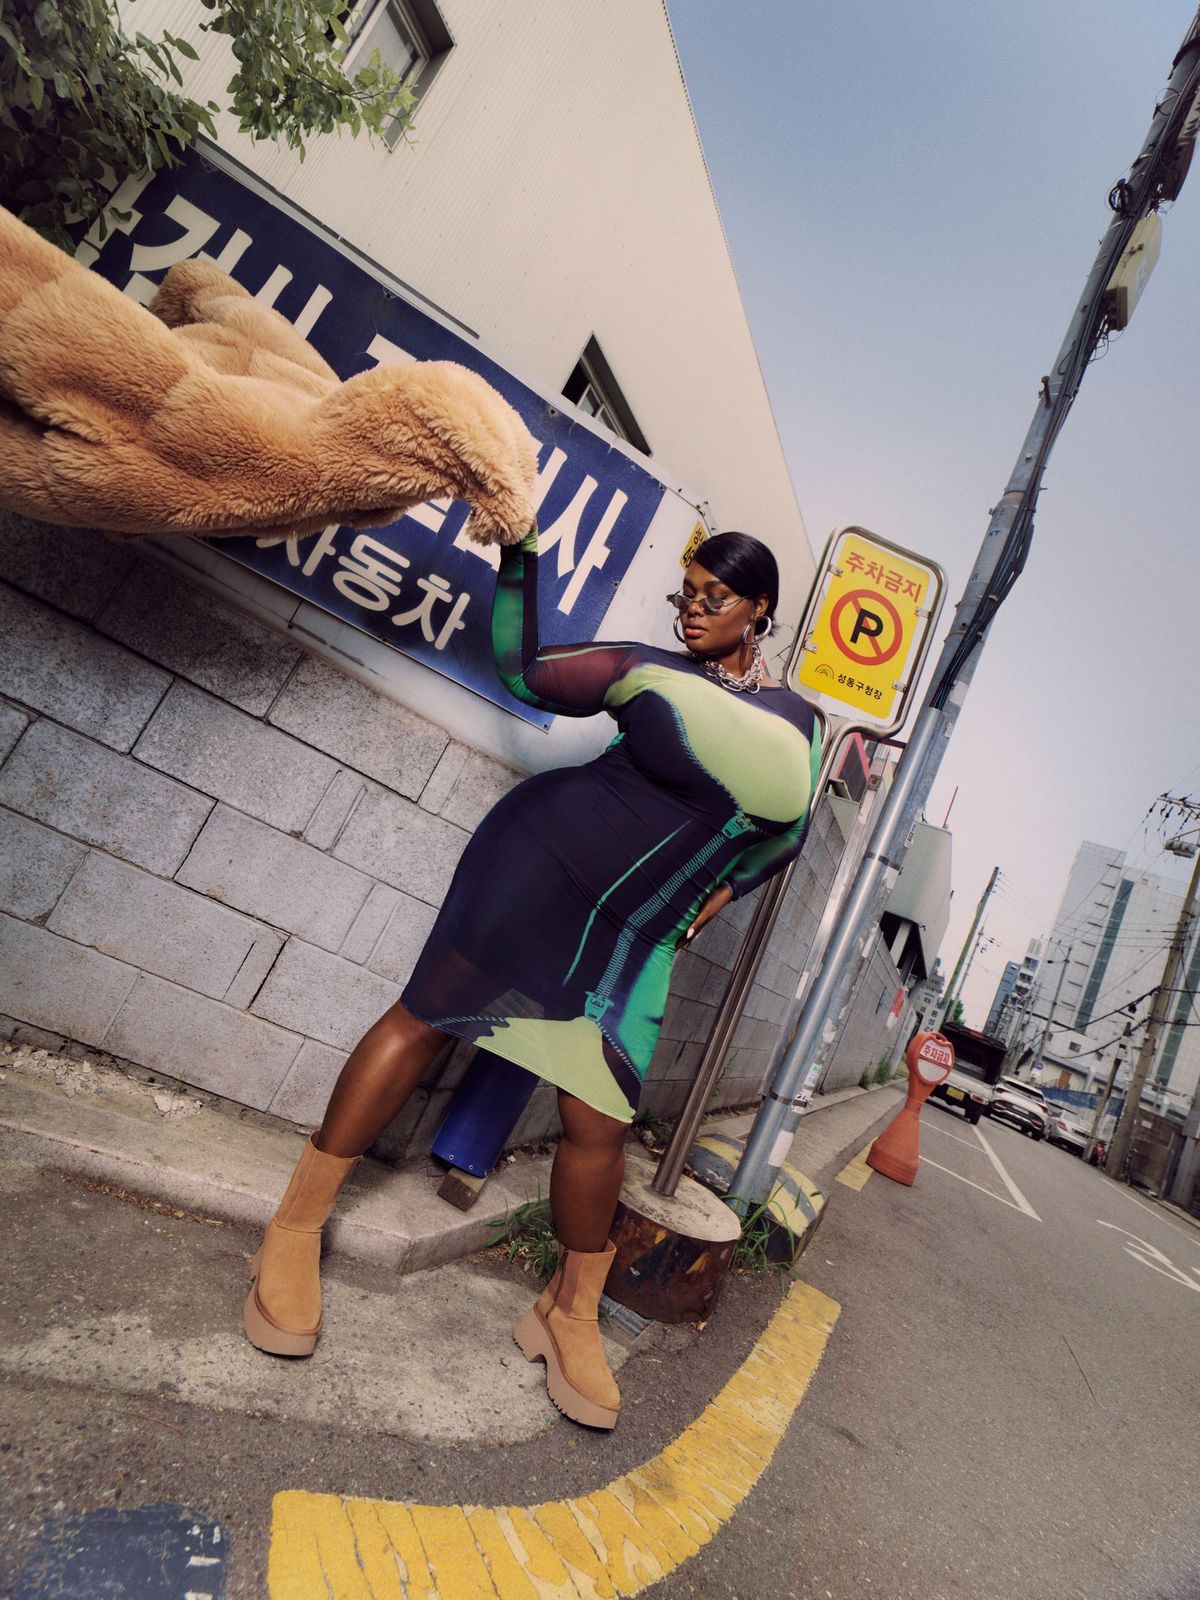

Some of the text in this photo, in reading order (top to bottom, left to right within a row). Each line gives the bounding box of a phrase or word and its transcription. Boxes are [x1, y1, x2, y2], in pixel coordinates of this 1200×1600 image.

[845, 552, 922, 603] 주차금지
[850, 608, 884, 645] P
[837, 673, 883, 700] 성동구청장
